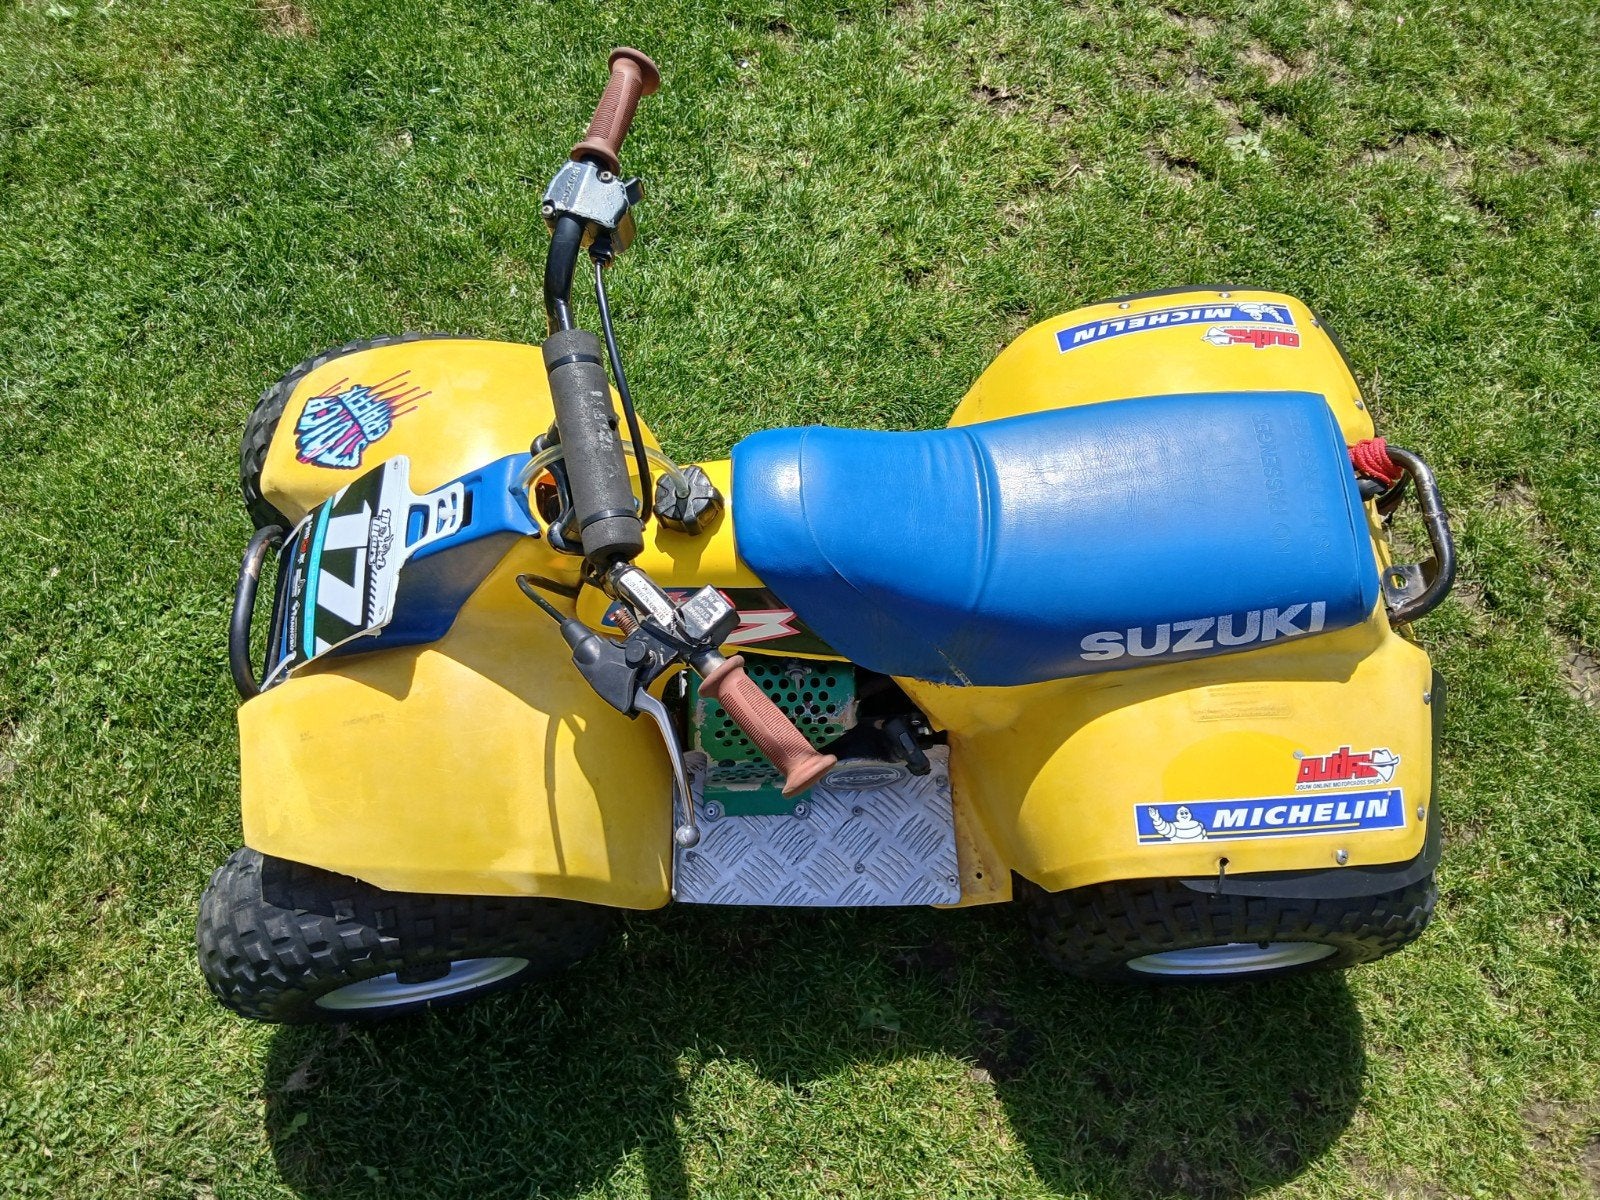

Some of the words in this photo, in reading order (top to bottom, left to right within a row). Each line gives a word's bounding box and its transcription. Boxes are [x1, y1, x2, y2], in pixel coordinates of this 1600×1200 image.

[1073, 307, 1232, 344] MICHELIN
[338, 385, 392, 442] GRAFFIX
[1251, 411, 1288, 515] PASSENGER
[1079, 600, 1327, 662] SUZUKI
[1212, 798, 1389, 828] MICHELIN
